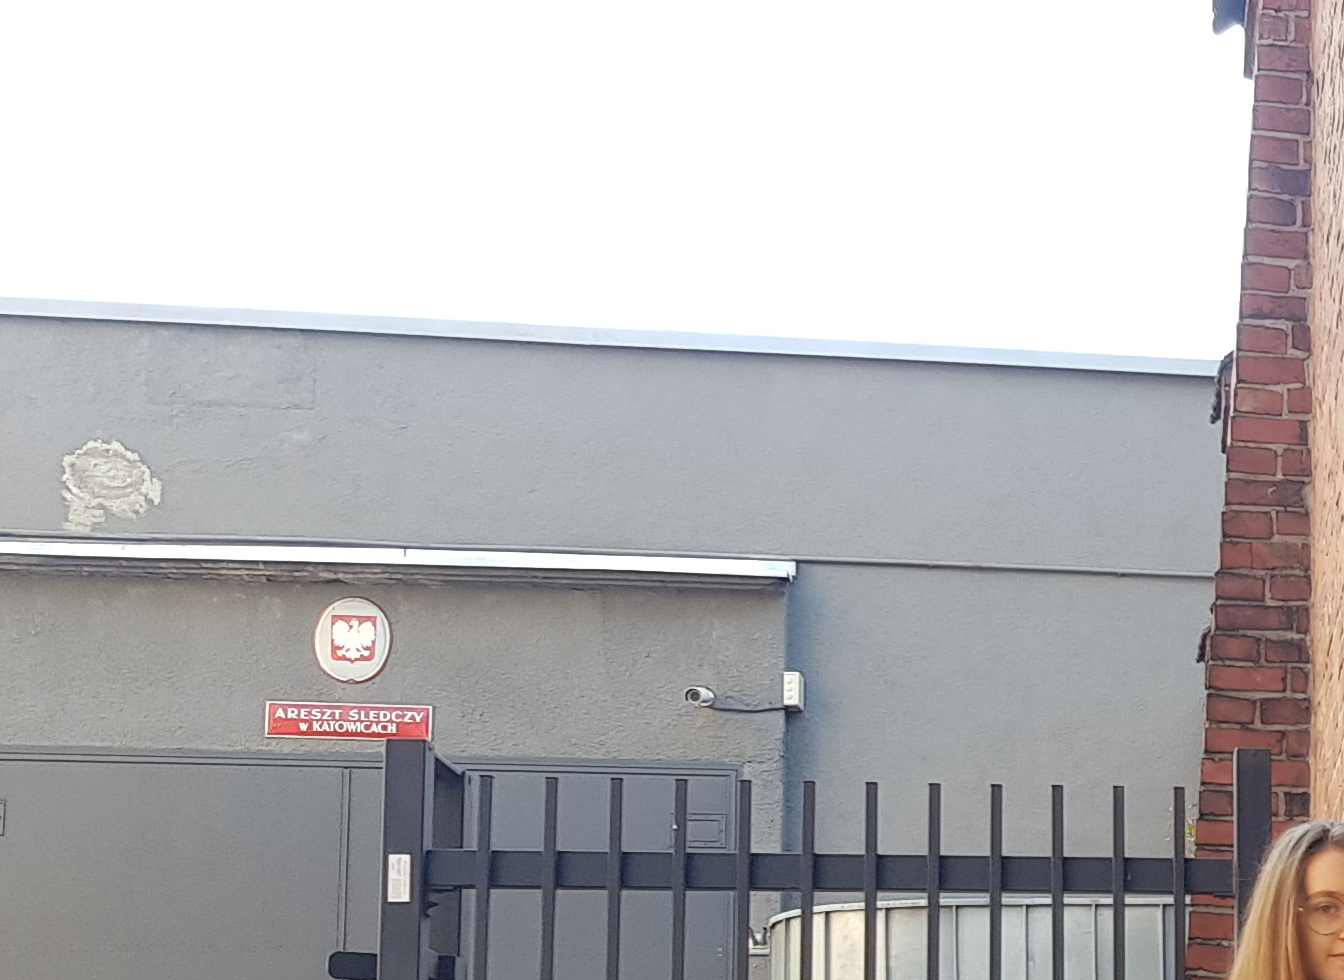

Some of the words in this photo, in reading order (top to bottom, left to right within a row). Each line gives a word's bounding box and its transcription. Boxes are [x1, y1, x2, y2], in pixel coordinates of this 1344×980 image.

[274, 707, 342, 720] ARESZT
[347, 708, 425, 723] ŚLEDCZY
[312, 721, 397, 734] KATOWICACH
